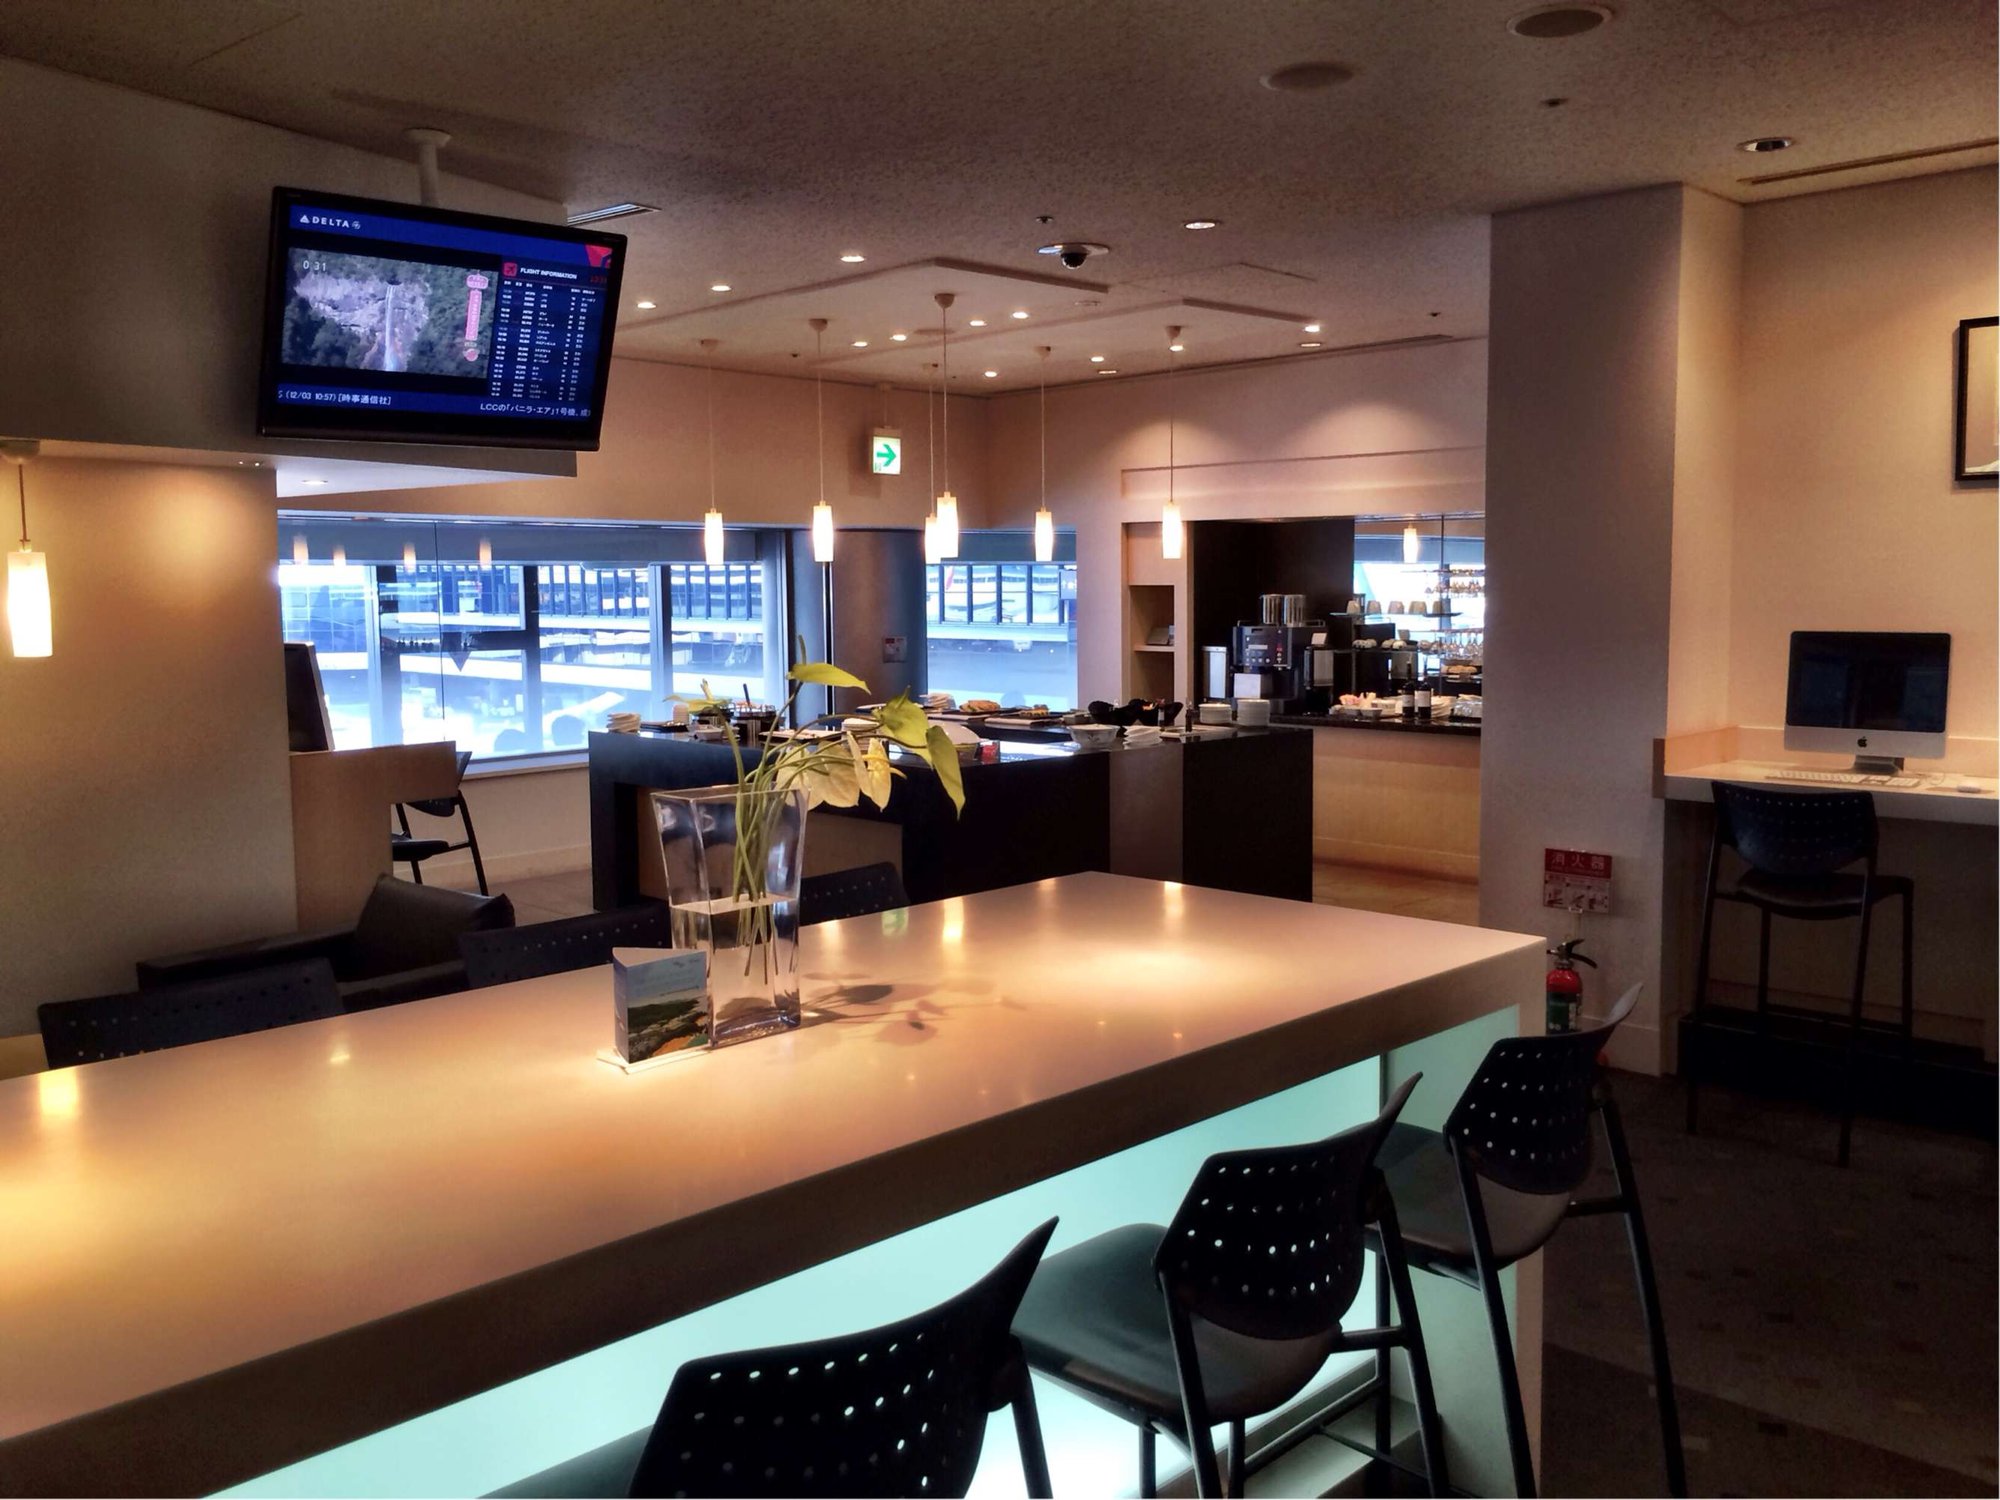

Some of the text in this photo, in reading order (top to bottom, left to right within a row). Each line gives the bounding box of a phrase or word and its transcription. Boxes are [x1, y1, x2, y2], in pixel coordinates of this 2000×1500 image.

[312, 216, 349, 228] DELTA
[520, 267, 578, 280] FLIGHT INFORMATION
